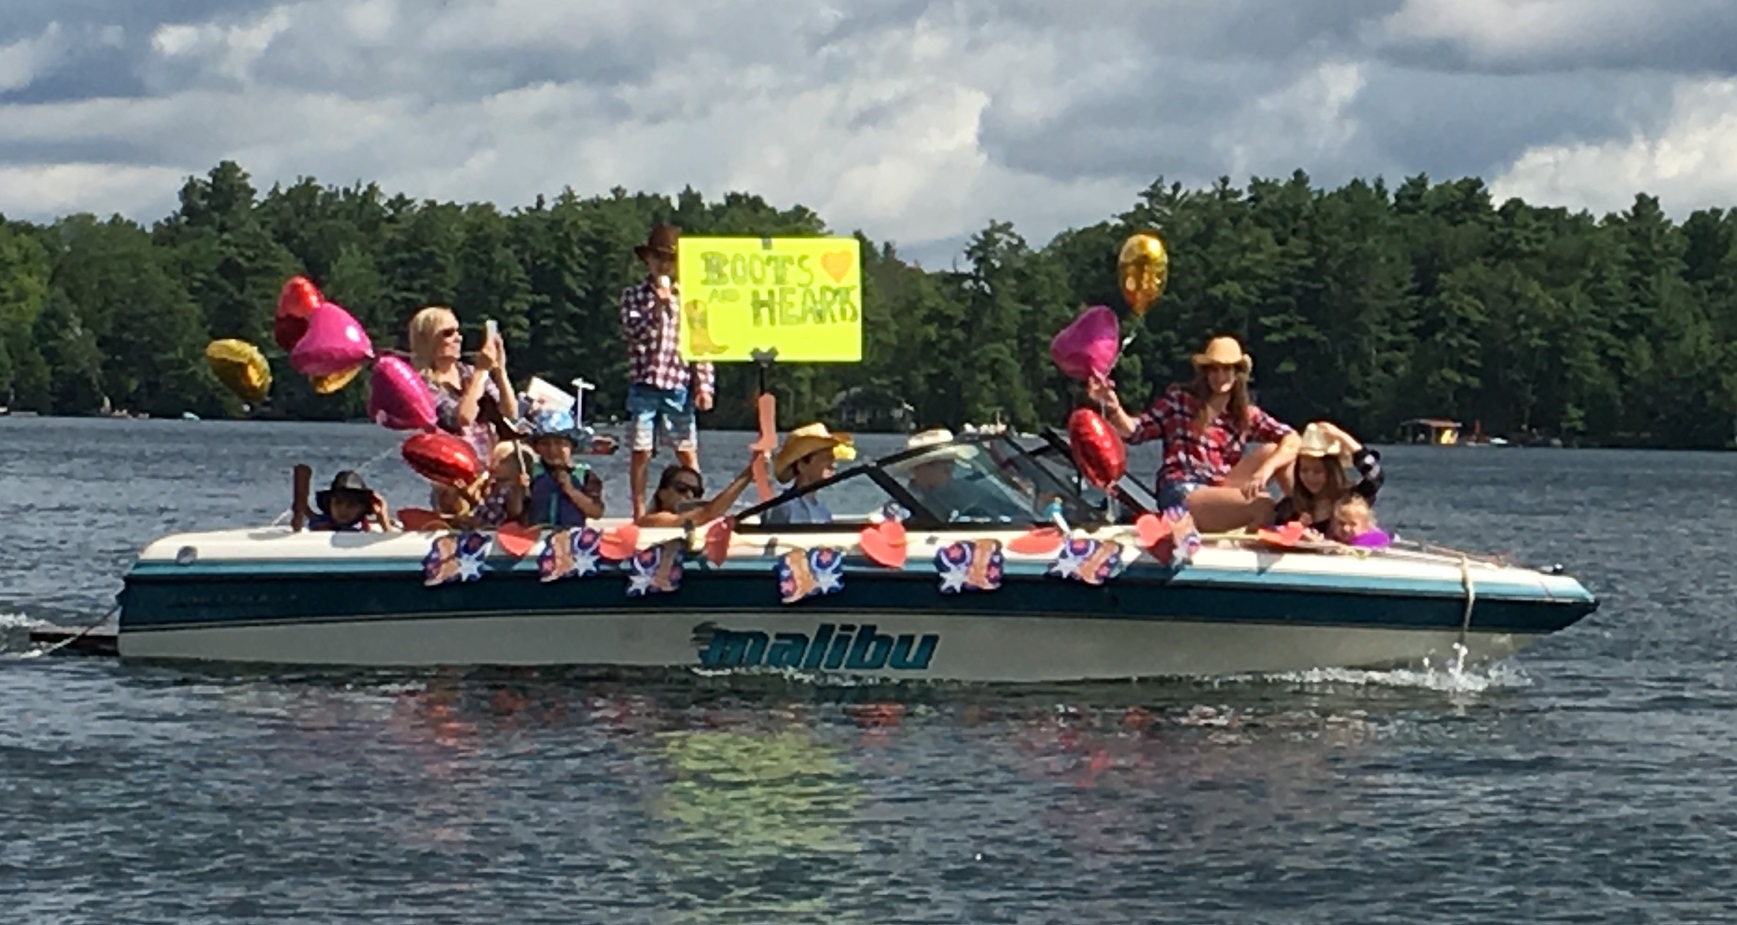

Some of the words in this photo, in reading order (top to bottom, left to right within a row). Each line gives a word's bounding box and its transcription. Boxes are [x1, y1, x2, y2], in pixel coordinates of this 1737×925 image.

[700, 251, 814, 287] BOOTS
[751, 285, 859, 326] HEARTS
[695, 623, 940, 670] malibu
